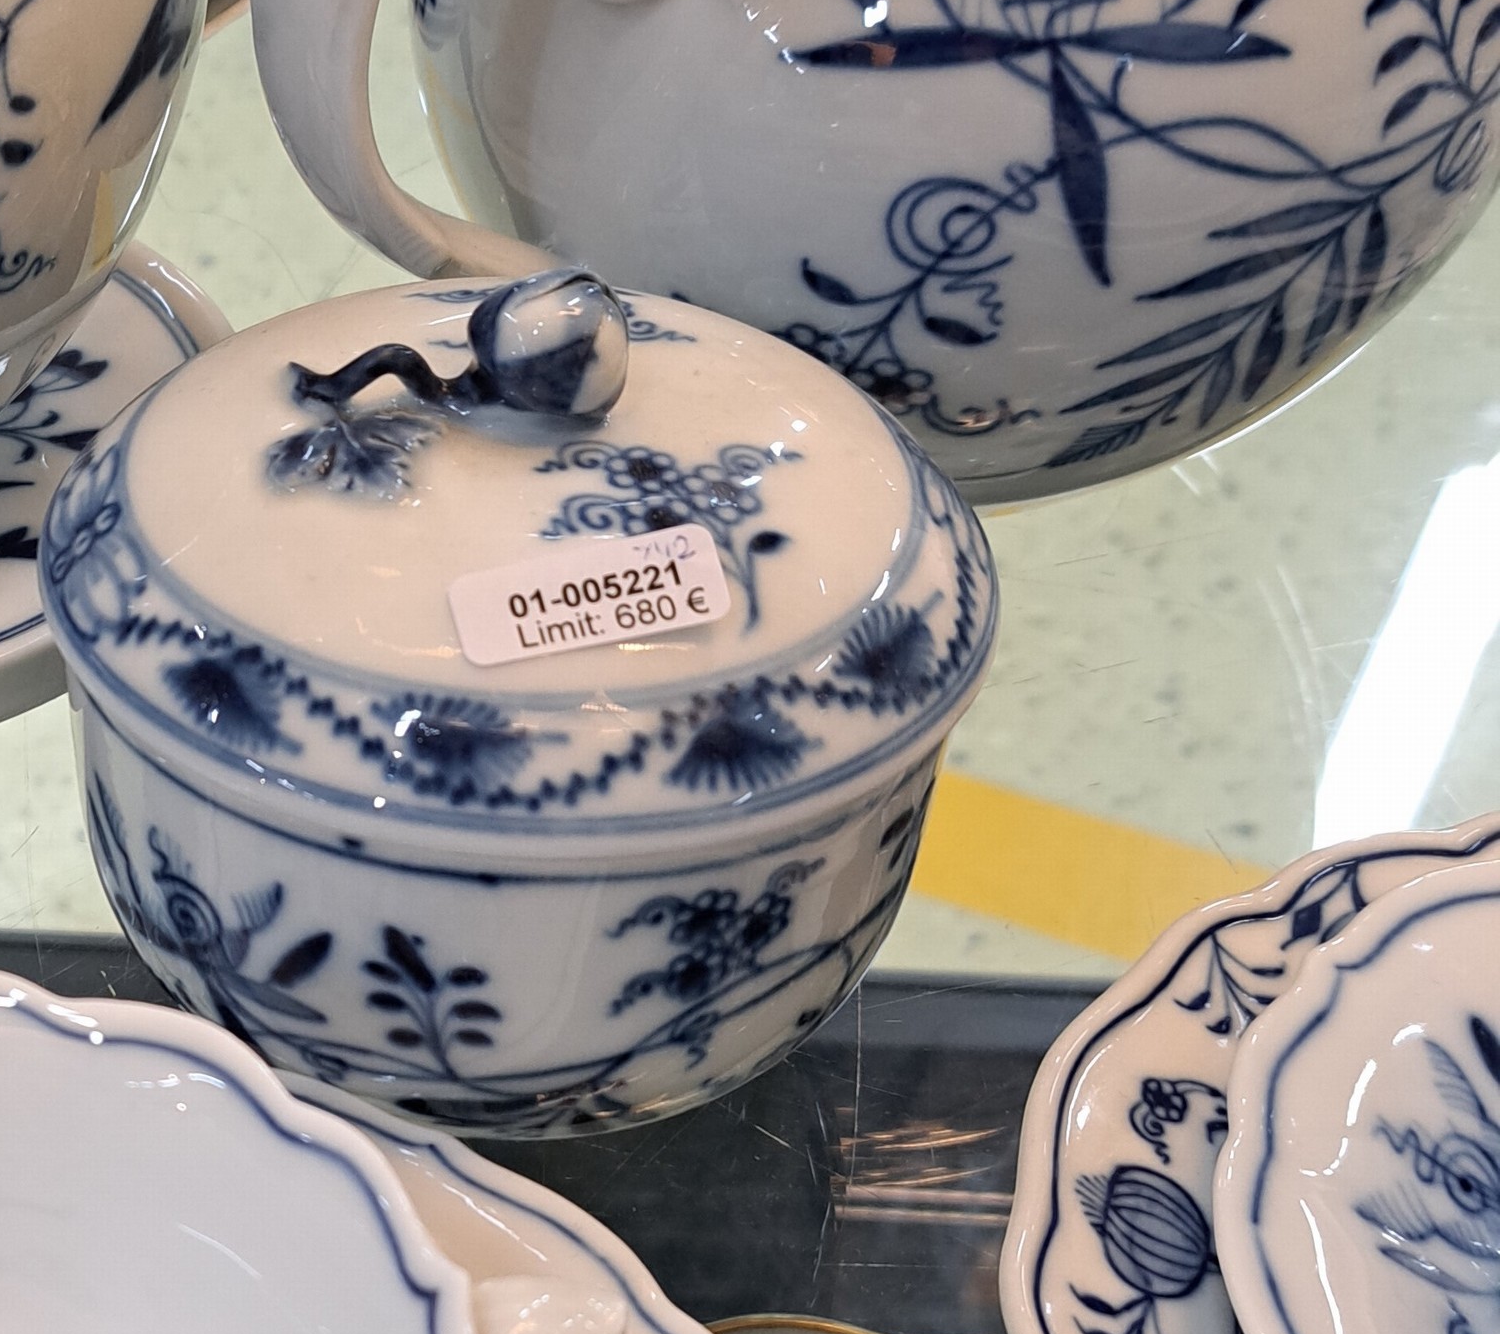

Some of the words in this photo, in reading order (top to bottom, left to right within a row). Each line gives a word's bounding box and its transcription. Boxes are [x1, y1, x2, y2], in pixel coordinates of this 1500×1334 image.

[508, 560, 682, 618] 01-005221
[516, 610, 605, 648] Limit:
[614, 594, 677, 629] 680
[687, 586, 709, 614] €
